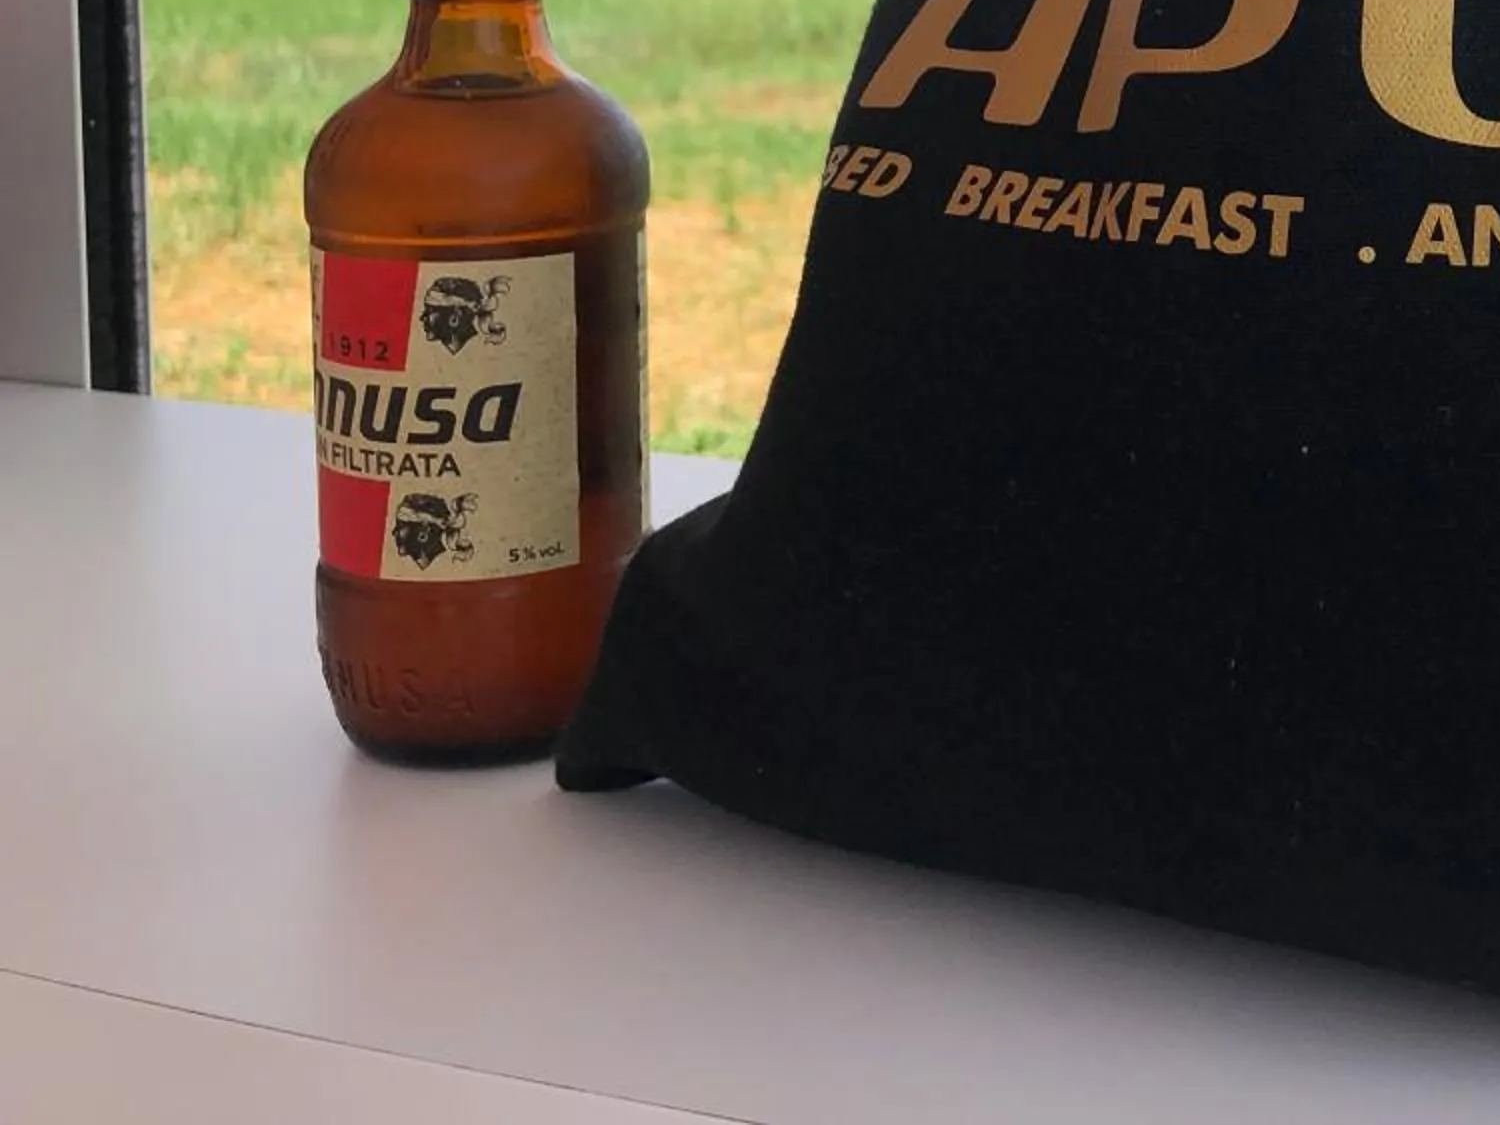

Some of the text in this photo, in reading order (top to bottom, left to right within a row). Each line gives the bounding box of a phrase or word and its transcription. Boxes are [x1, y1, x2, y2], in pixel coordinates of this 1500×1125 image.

[824, 144, 913, 198] BED
[944, 163, 1304, 258] BREAKFAST
[327, 331, 389, 363] 1912
[331, 443, 461, 478] FILTRATA
